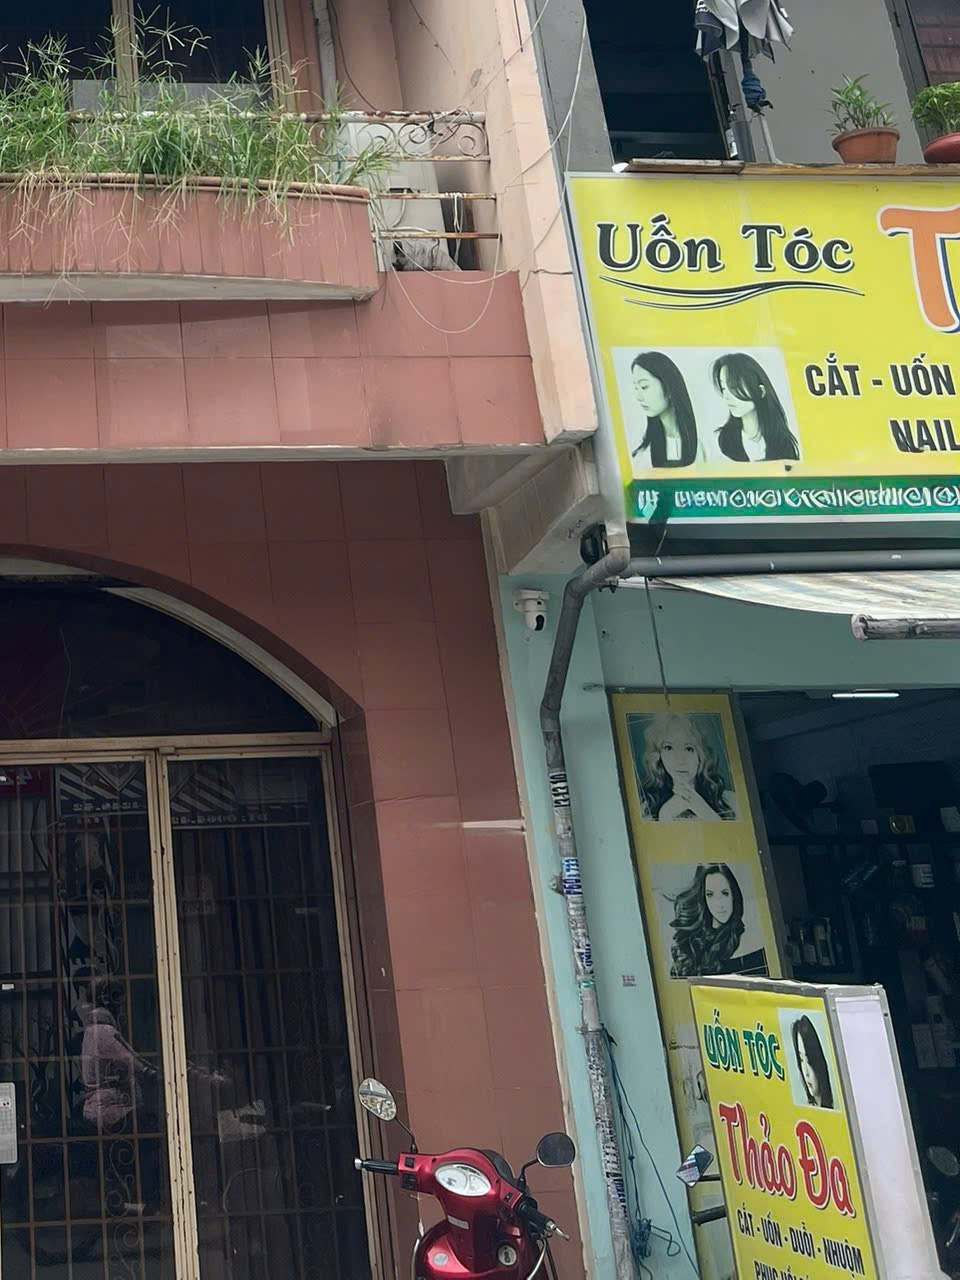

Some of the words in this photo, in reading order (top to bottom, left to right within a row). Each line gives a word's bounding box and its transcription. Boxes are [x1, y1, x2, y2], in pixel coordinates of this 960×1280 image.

[596, 213, 724, 273] Uốn
[741, 225, 855, 273] Tóc
[805, 352, 861, 397] CẮT
[890, 352, 955, 397] UỐN
[889, 419, 960, 454] NAIL
[703, 1008, 744, 1073] UỐN
[718, 1101, 797, 1201] Thảo
[795, 1120, 856, 1219] Đa
[737, 1202, 755, 1237] CẮT
[761, 1212, 783, 1248] UỐN
[822, 1239, 865, 1278] NHUỘM
